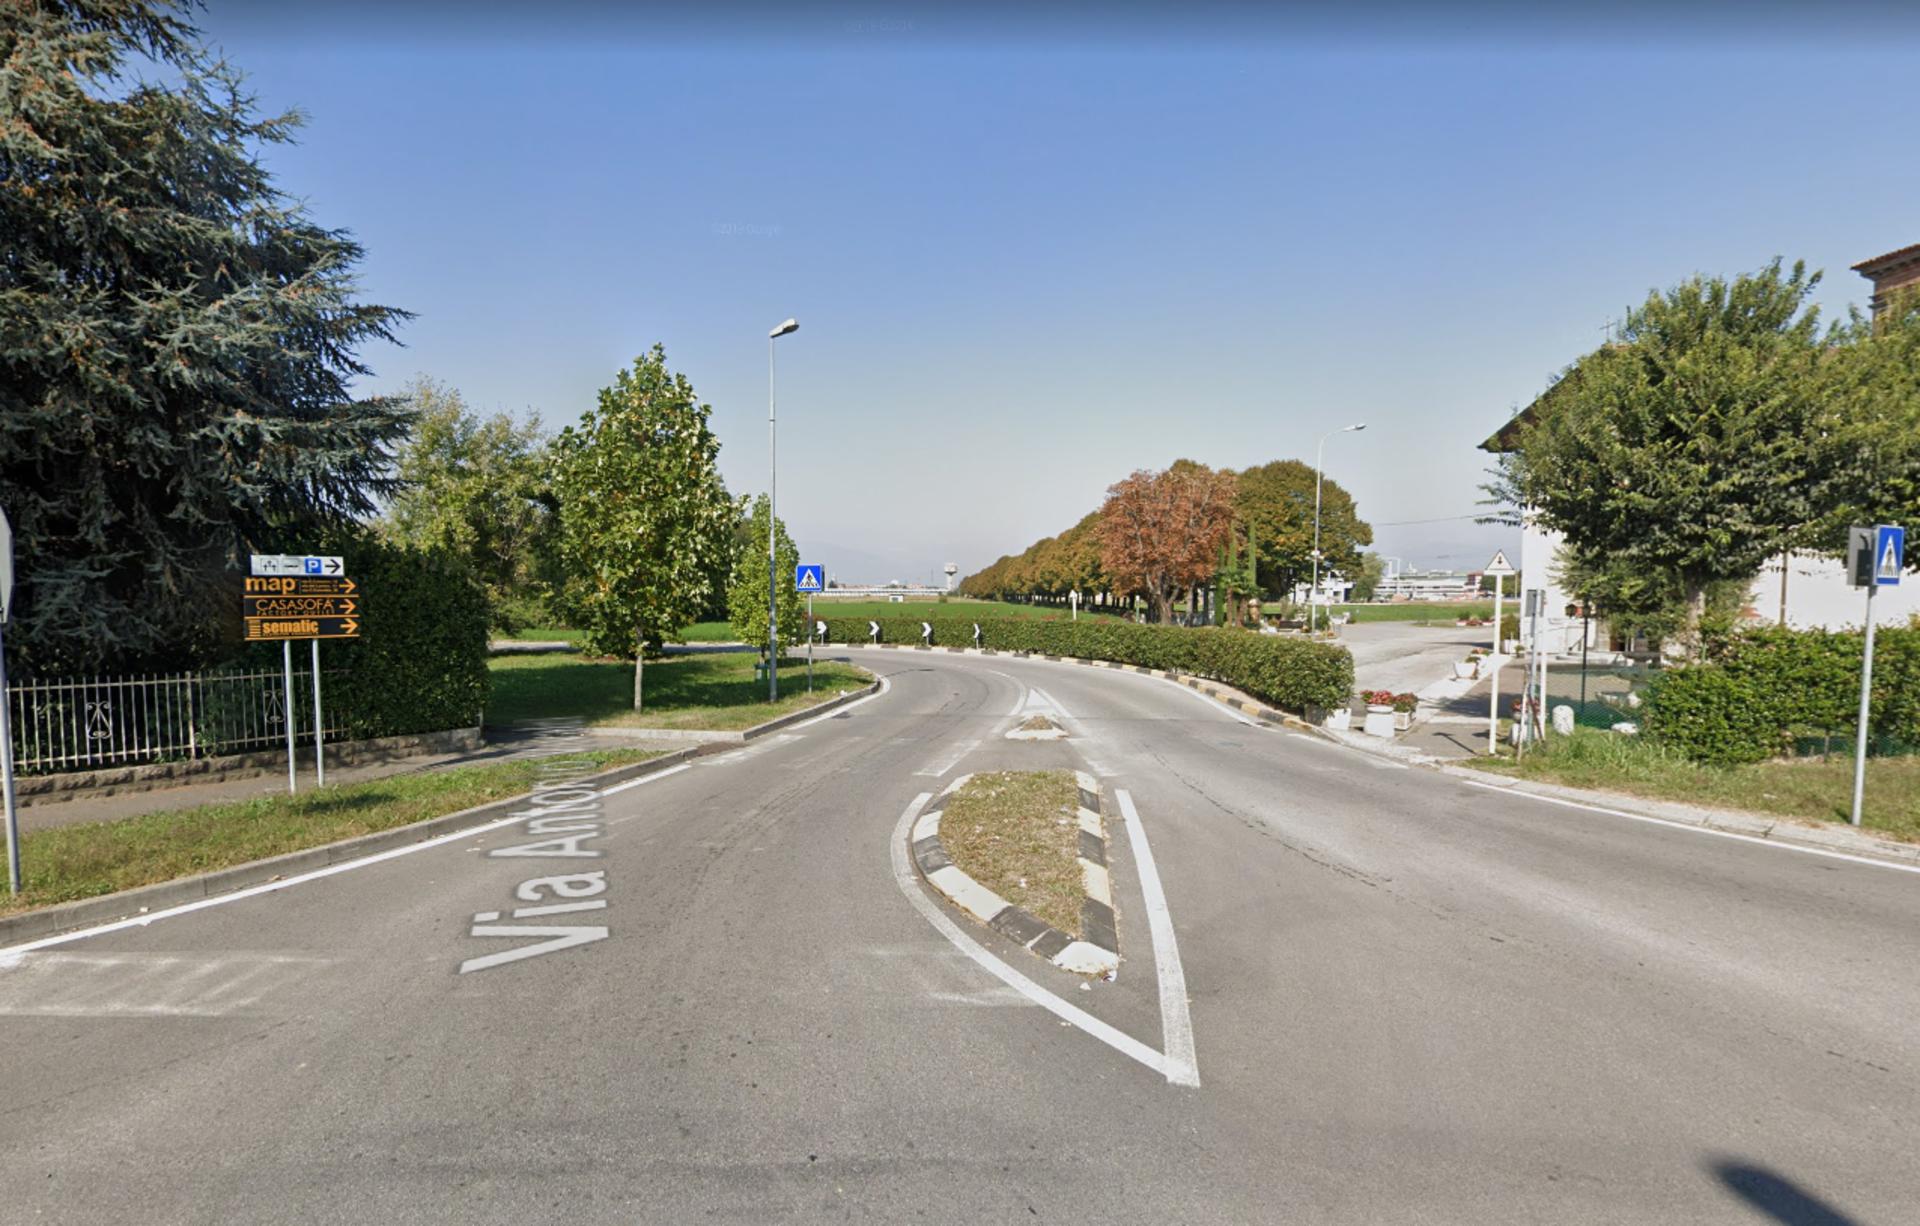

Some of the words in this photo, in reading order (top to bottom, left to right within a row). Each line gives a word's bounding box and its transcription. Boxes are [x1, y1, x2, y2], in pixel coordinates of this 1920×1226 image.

[307, 559, 320, 573] P
[245, 577, 296, 594] map
[262, 620, 319, 633] sematic
